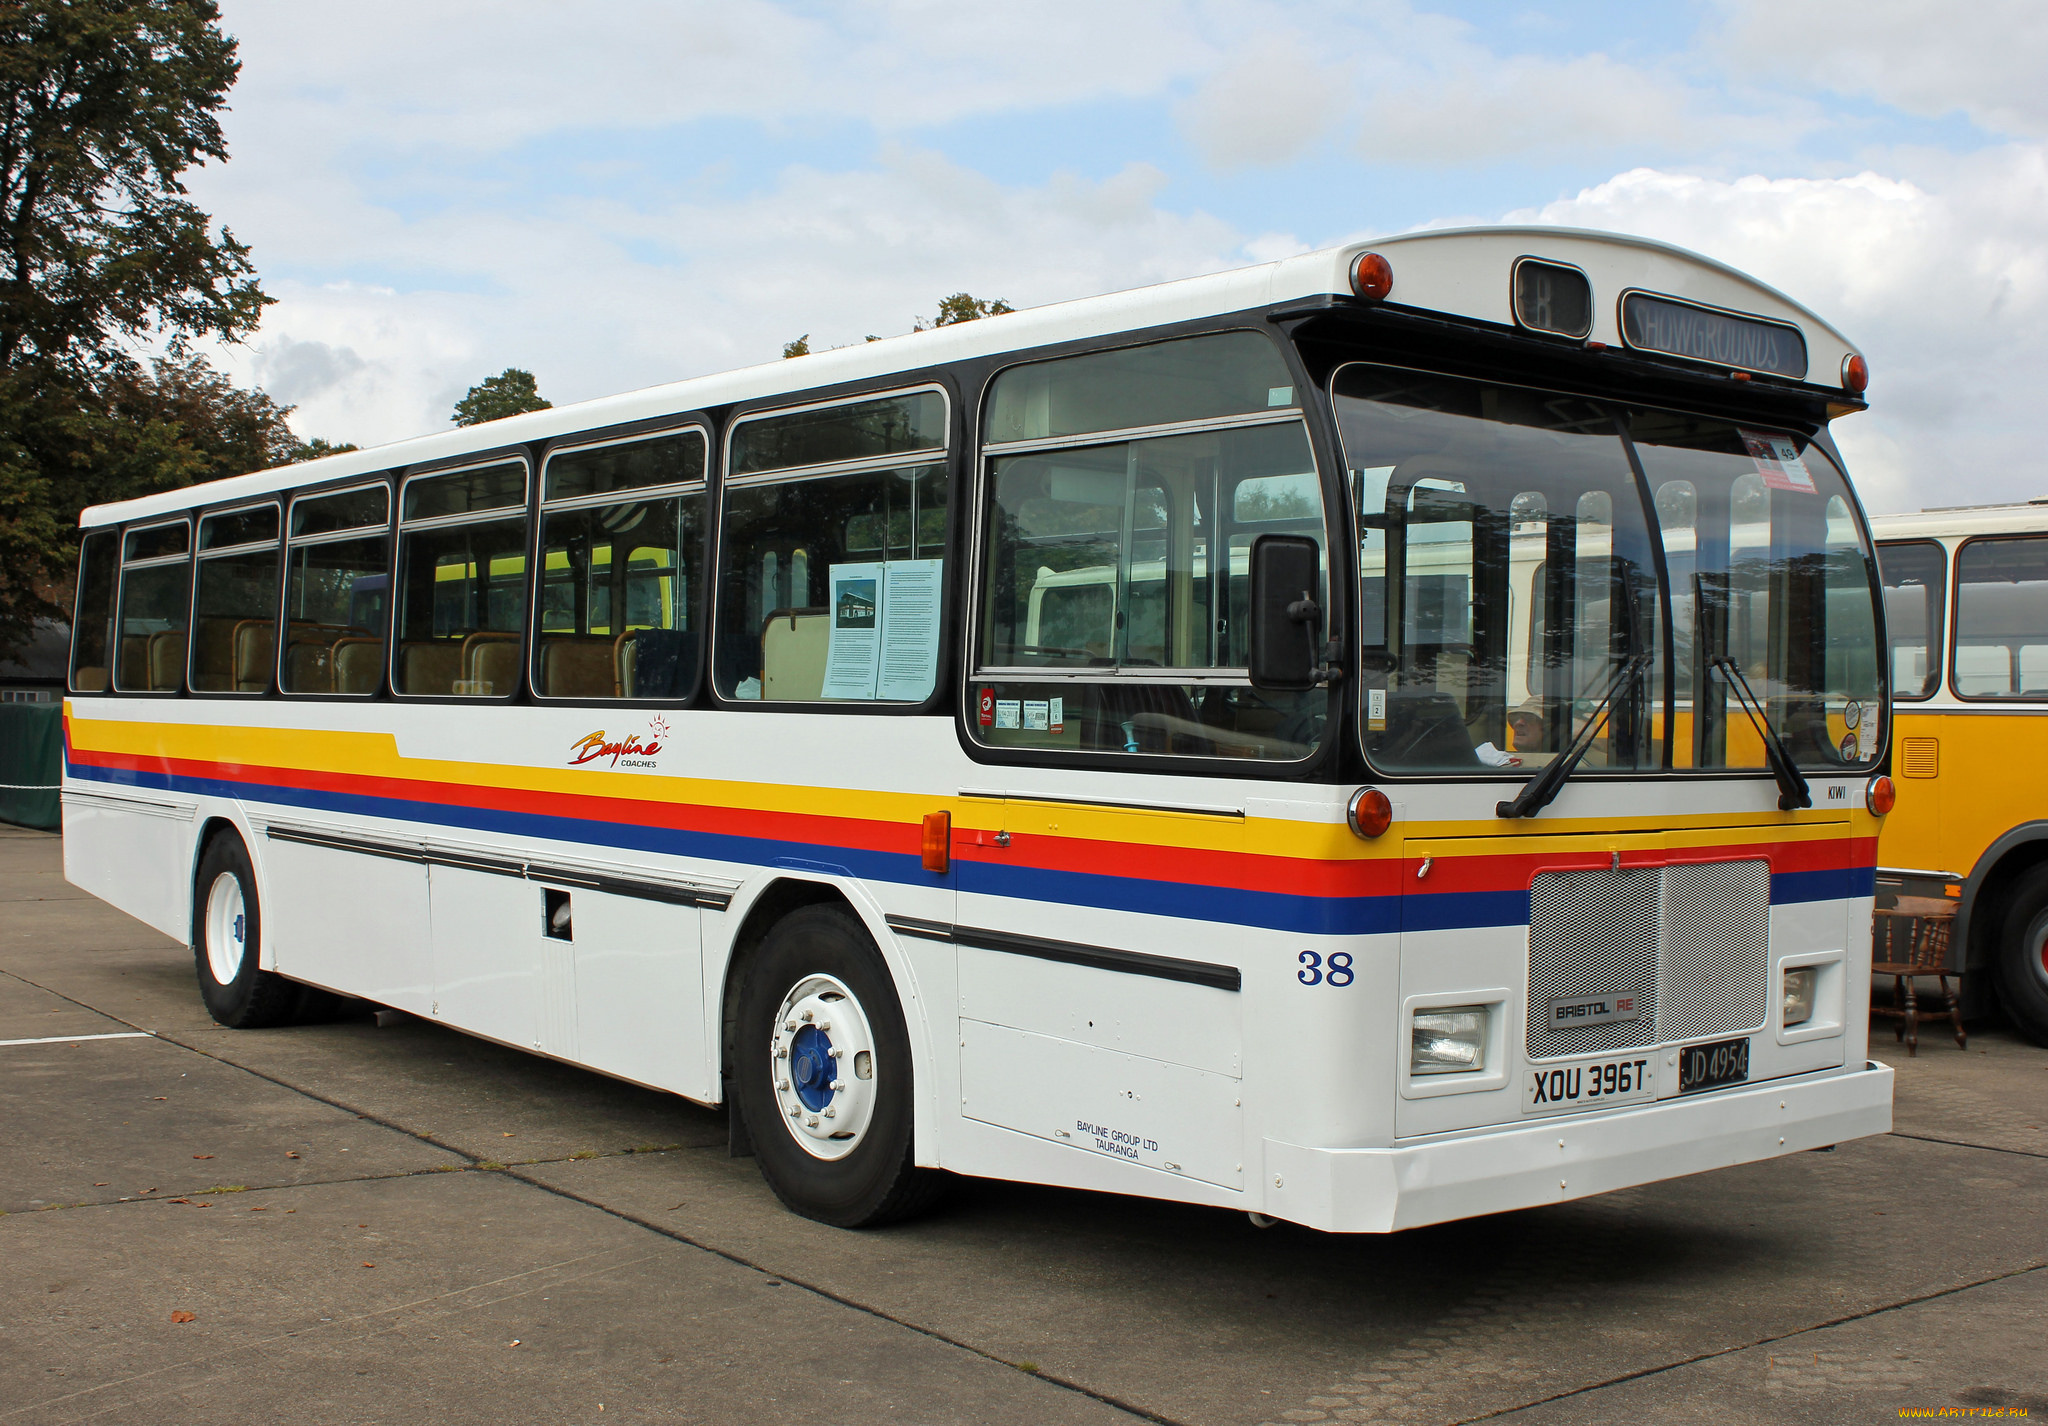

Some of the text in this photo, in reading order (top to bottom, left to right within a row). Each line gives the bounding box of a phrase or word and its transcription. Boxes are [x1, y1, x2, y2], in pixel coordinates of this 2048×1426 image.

[1634, 304, 1779, 369] SHOWGROUNDS
[1781, 448, 1795, 460] 49
[567, 730, 662, 768] Bayline
[621, 759, 657, 768] COACHES
[1828, 786, 1846, 799] KIWI
[1298, 950, 1354, 987] 38
[1556, 1002, 1610, 1020] BRISTOL
[1684, 1044, 1747, 1085] JD 4954
[1533, 1060, 1647, 1104] XOU 396T
[1077, 1120, 1158, 1152] BAYLINE GROUP LTD
[1095, 1138, 1139, 1159] TAURANGA
